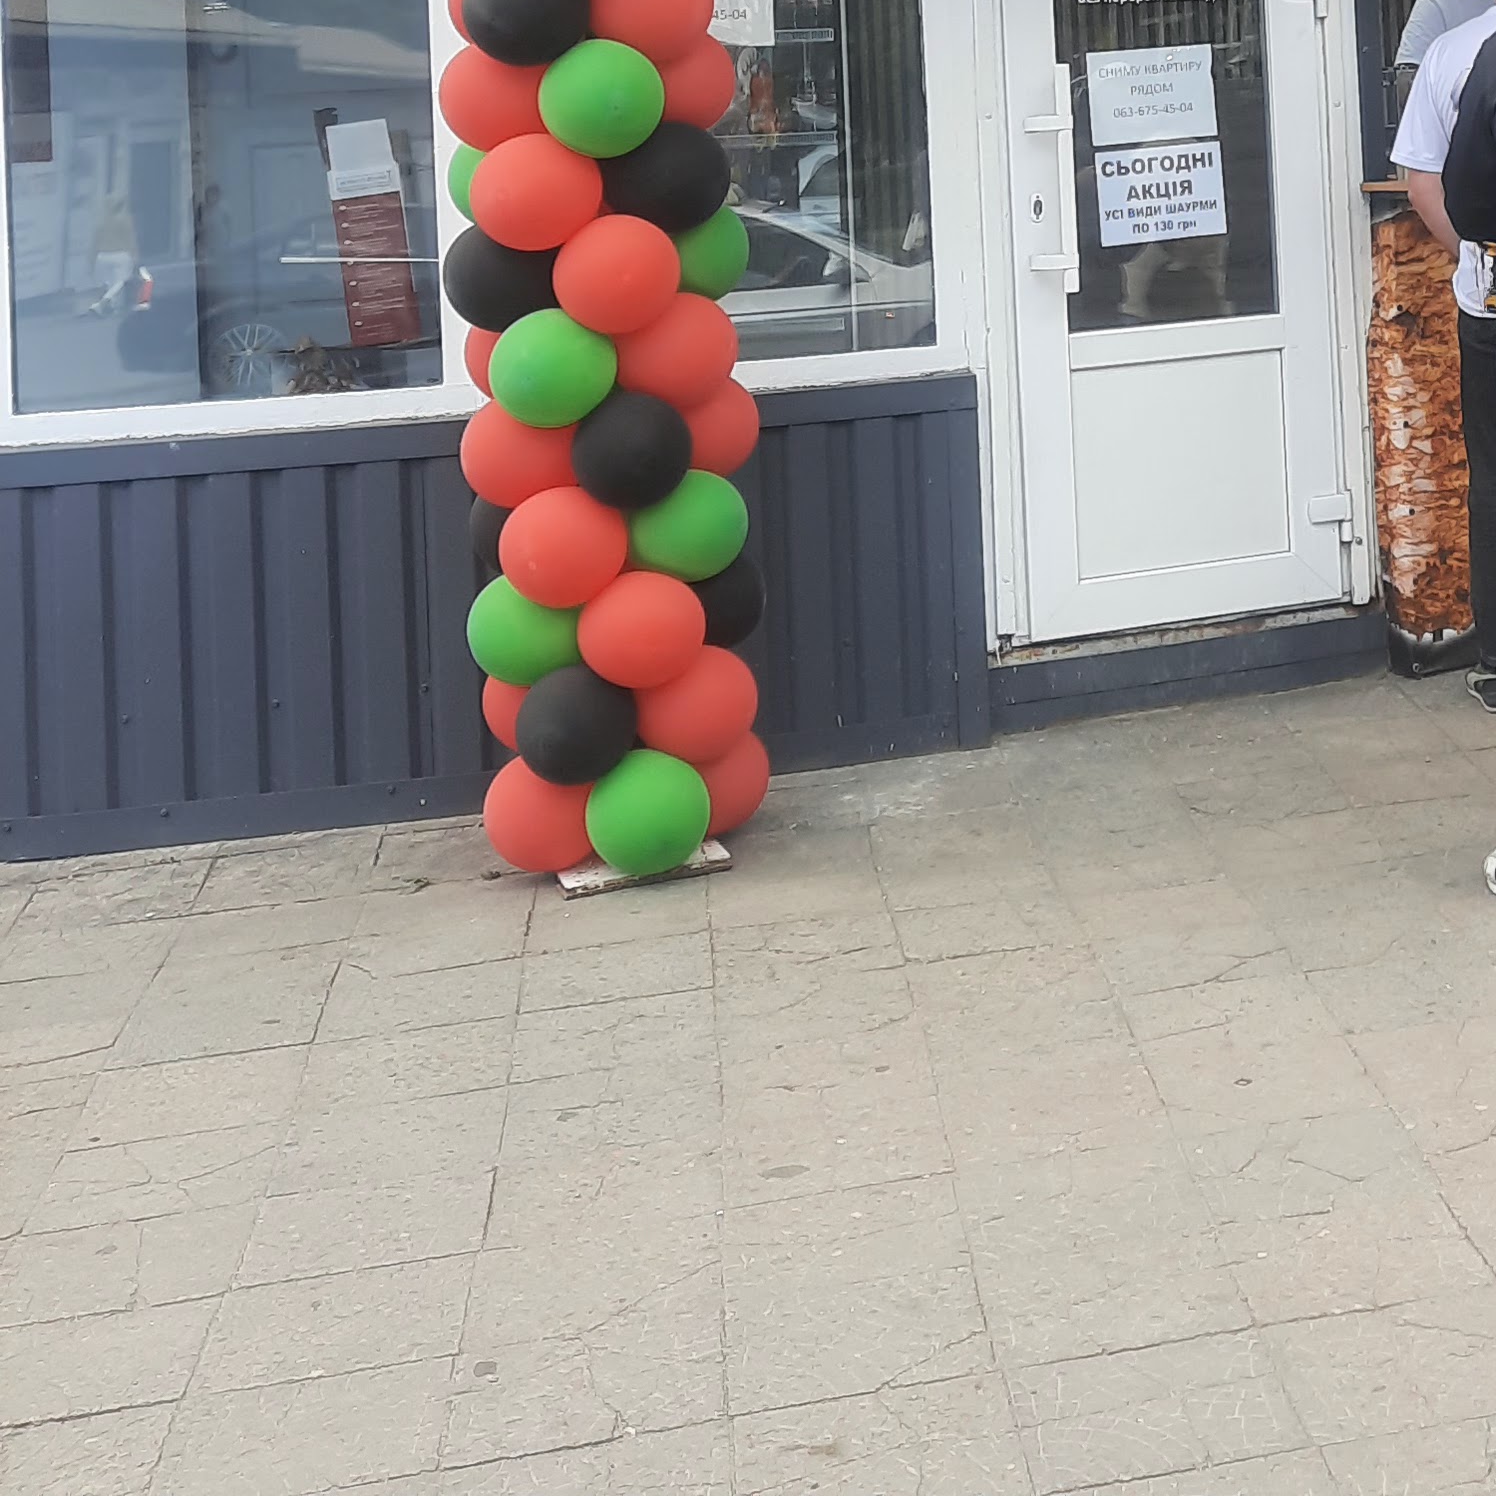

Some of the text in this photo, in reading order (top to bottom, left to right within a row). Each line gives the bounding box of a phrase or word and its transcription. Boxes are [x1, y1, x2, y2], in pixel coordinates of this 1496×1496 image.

[1098, 61, 1203, 79] СНИМУ КВАРТИРУ
[1130, 82, 1174, 96] РЯДОМ
[1101, 151, 1214, 179] СЬОГОДНІ
[1126, 178, 1194, 202] АКЦІЯ
[1104, 199, 1218, 222] УСІ ВИДИ ШАУРМИ
[1132, 223, 1150, 234] ПО
[1154, 219, 1174, 232] 130
